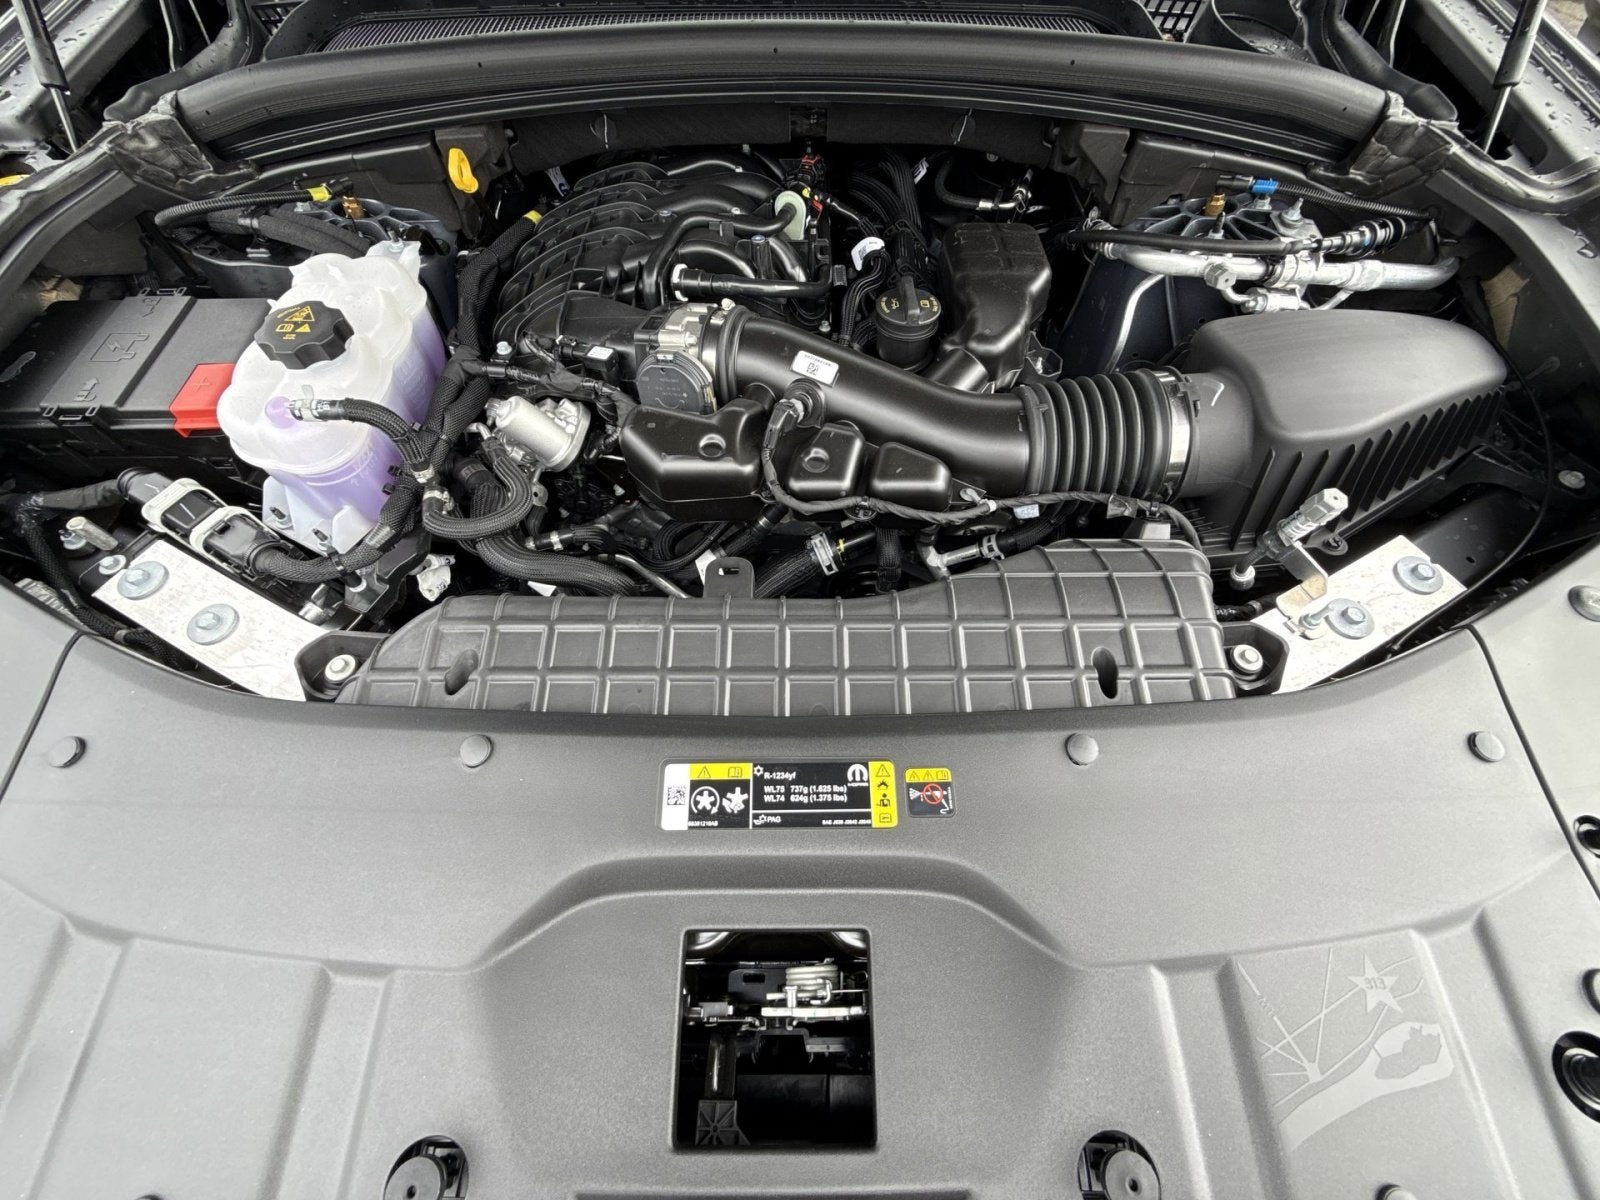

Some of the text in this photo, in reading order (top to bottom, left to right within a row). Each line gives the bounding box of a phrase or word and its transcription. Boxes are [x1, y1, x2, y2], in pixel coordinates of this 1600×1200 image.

[763, 772, 797, 781] R-1234yf
[763, 785, 848, 794] WL75 737g (1.625 lbs)
[763, 794, 785, 803] WL74
[809, 794, 832, 803] (1.375
[832, 794, 848, 803] lbs)
[767, 816, 781, 824] PAG
